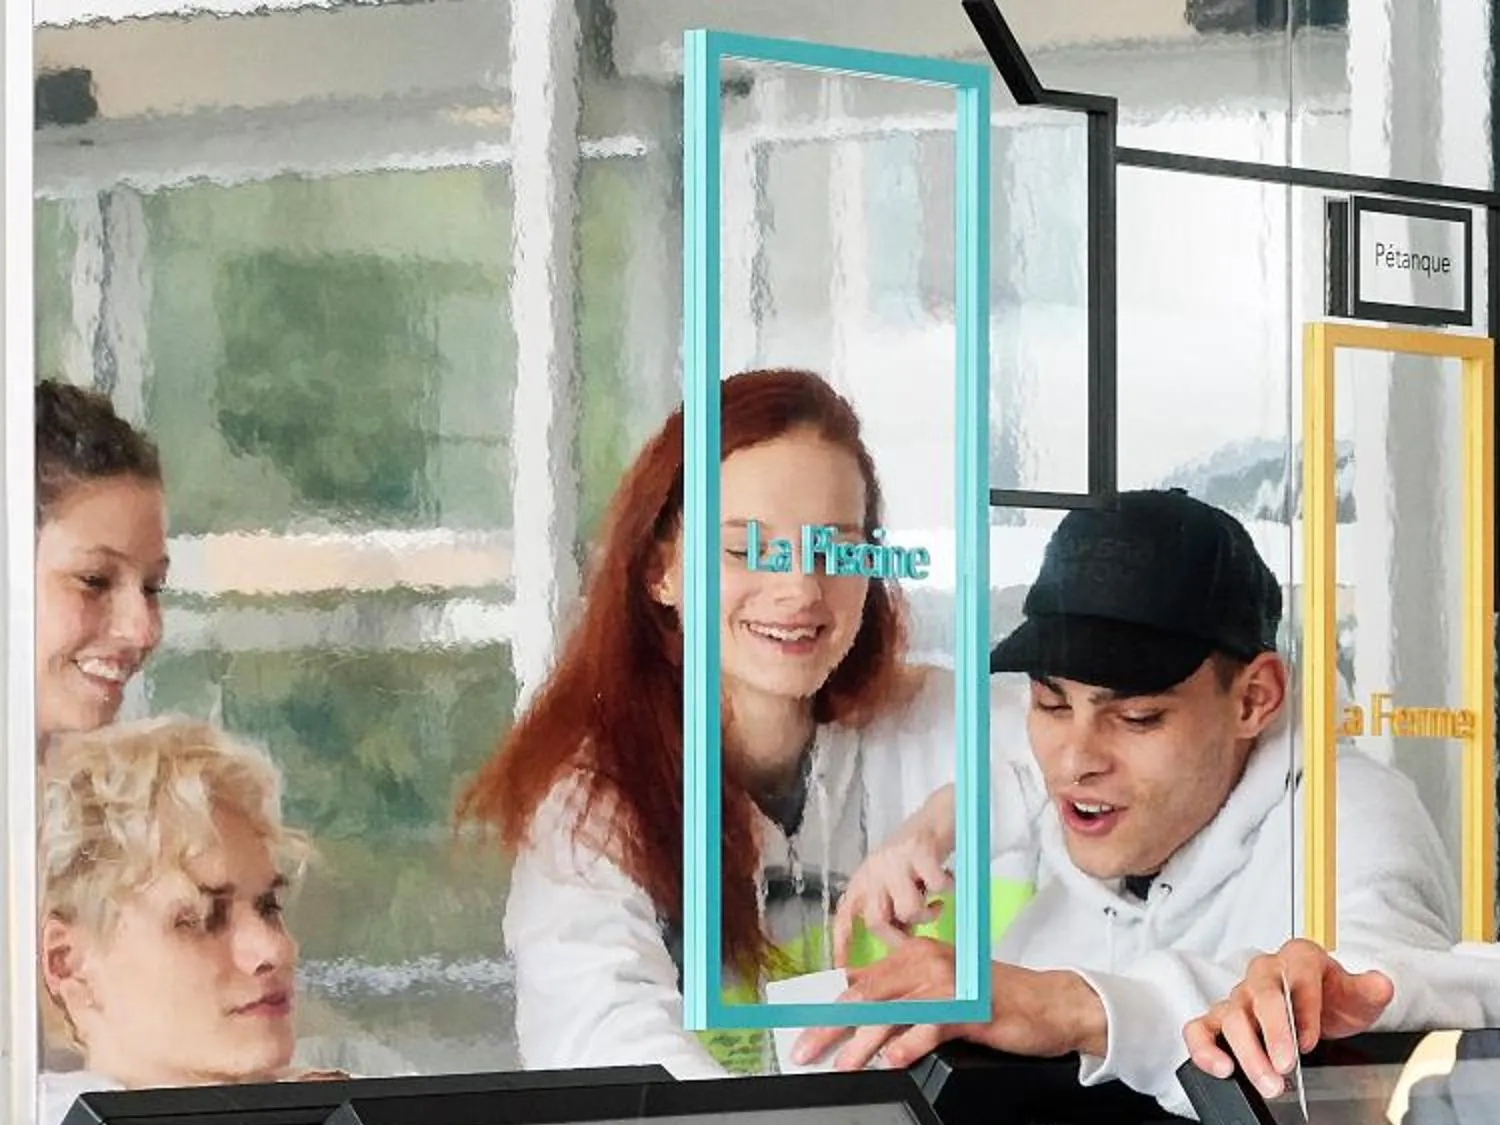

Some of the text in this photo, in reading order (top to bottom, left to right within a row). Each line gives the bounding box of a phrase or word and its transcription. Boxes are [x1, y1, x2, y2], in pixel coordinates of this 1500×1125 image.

[1375, 242, 1451, 278] Pétanque
[747, 519, 932, 581] La Piscine
